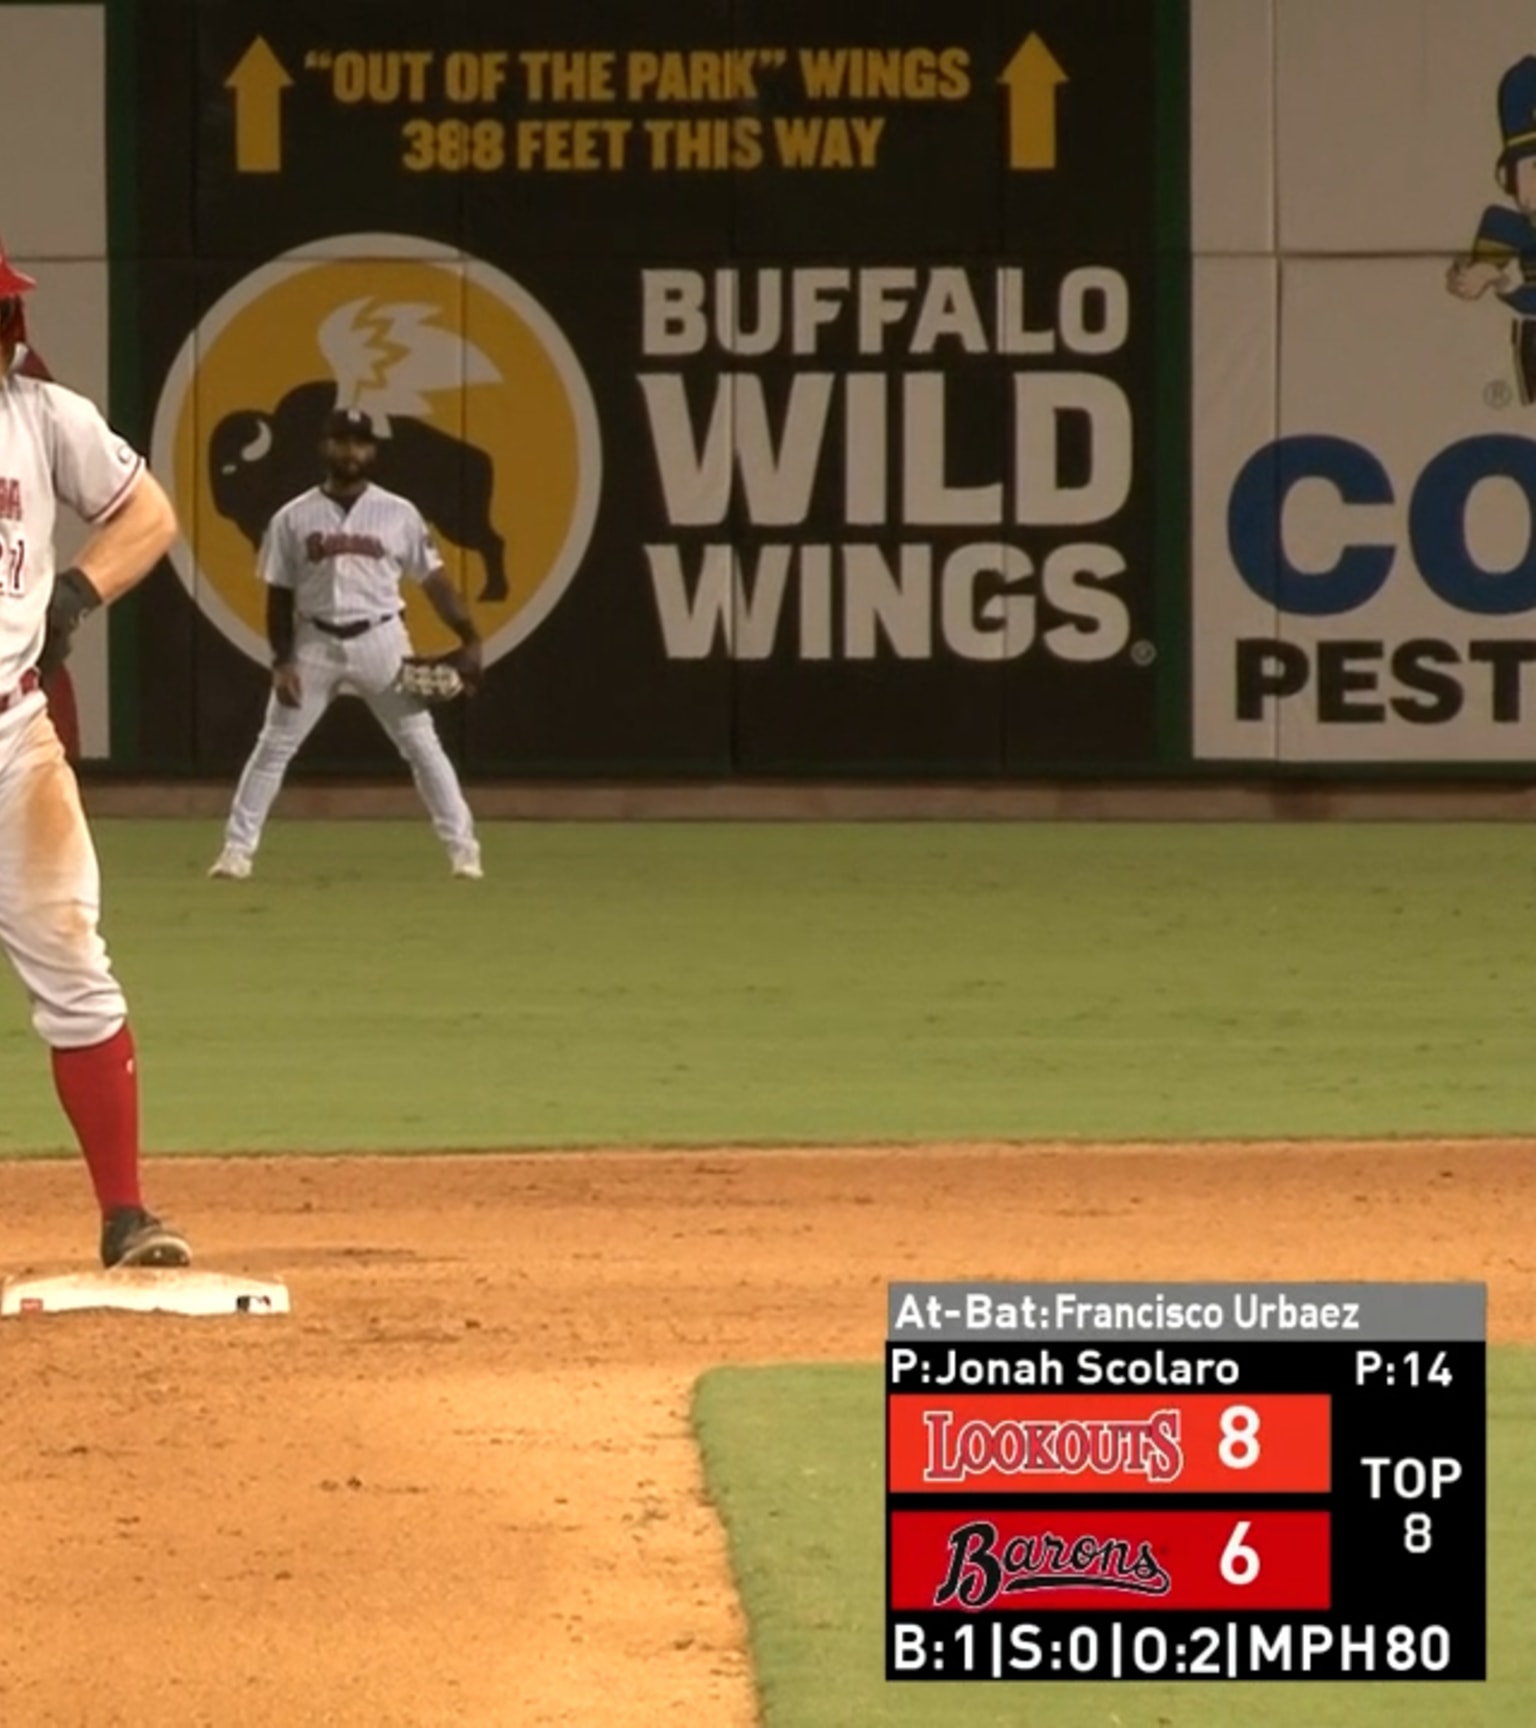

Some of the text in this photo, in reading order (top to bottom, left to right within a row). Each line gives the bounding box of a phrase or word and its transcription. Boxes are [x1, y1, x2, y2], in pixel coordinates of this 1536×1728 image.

[446, 50, 509, 102] OF
[523, 51, 625, 101] THE
[800, 48, 972, 100] WINGS
[403, 118, 885, 171] 388 FEET THIS WAY
[641, 266, 1129, 355] BUFFALO
[637, 371, 1133, 525] WILD
[644, 543, 1130, 661] WINGS
[1235, 638, 1536, 724] PEST
